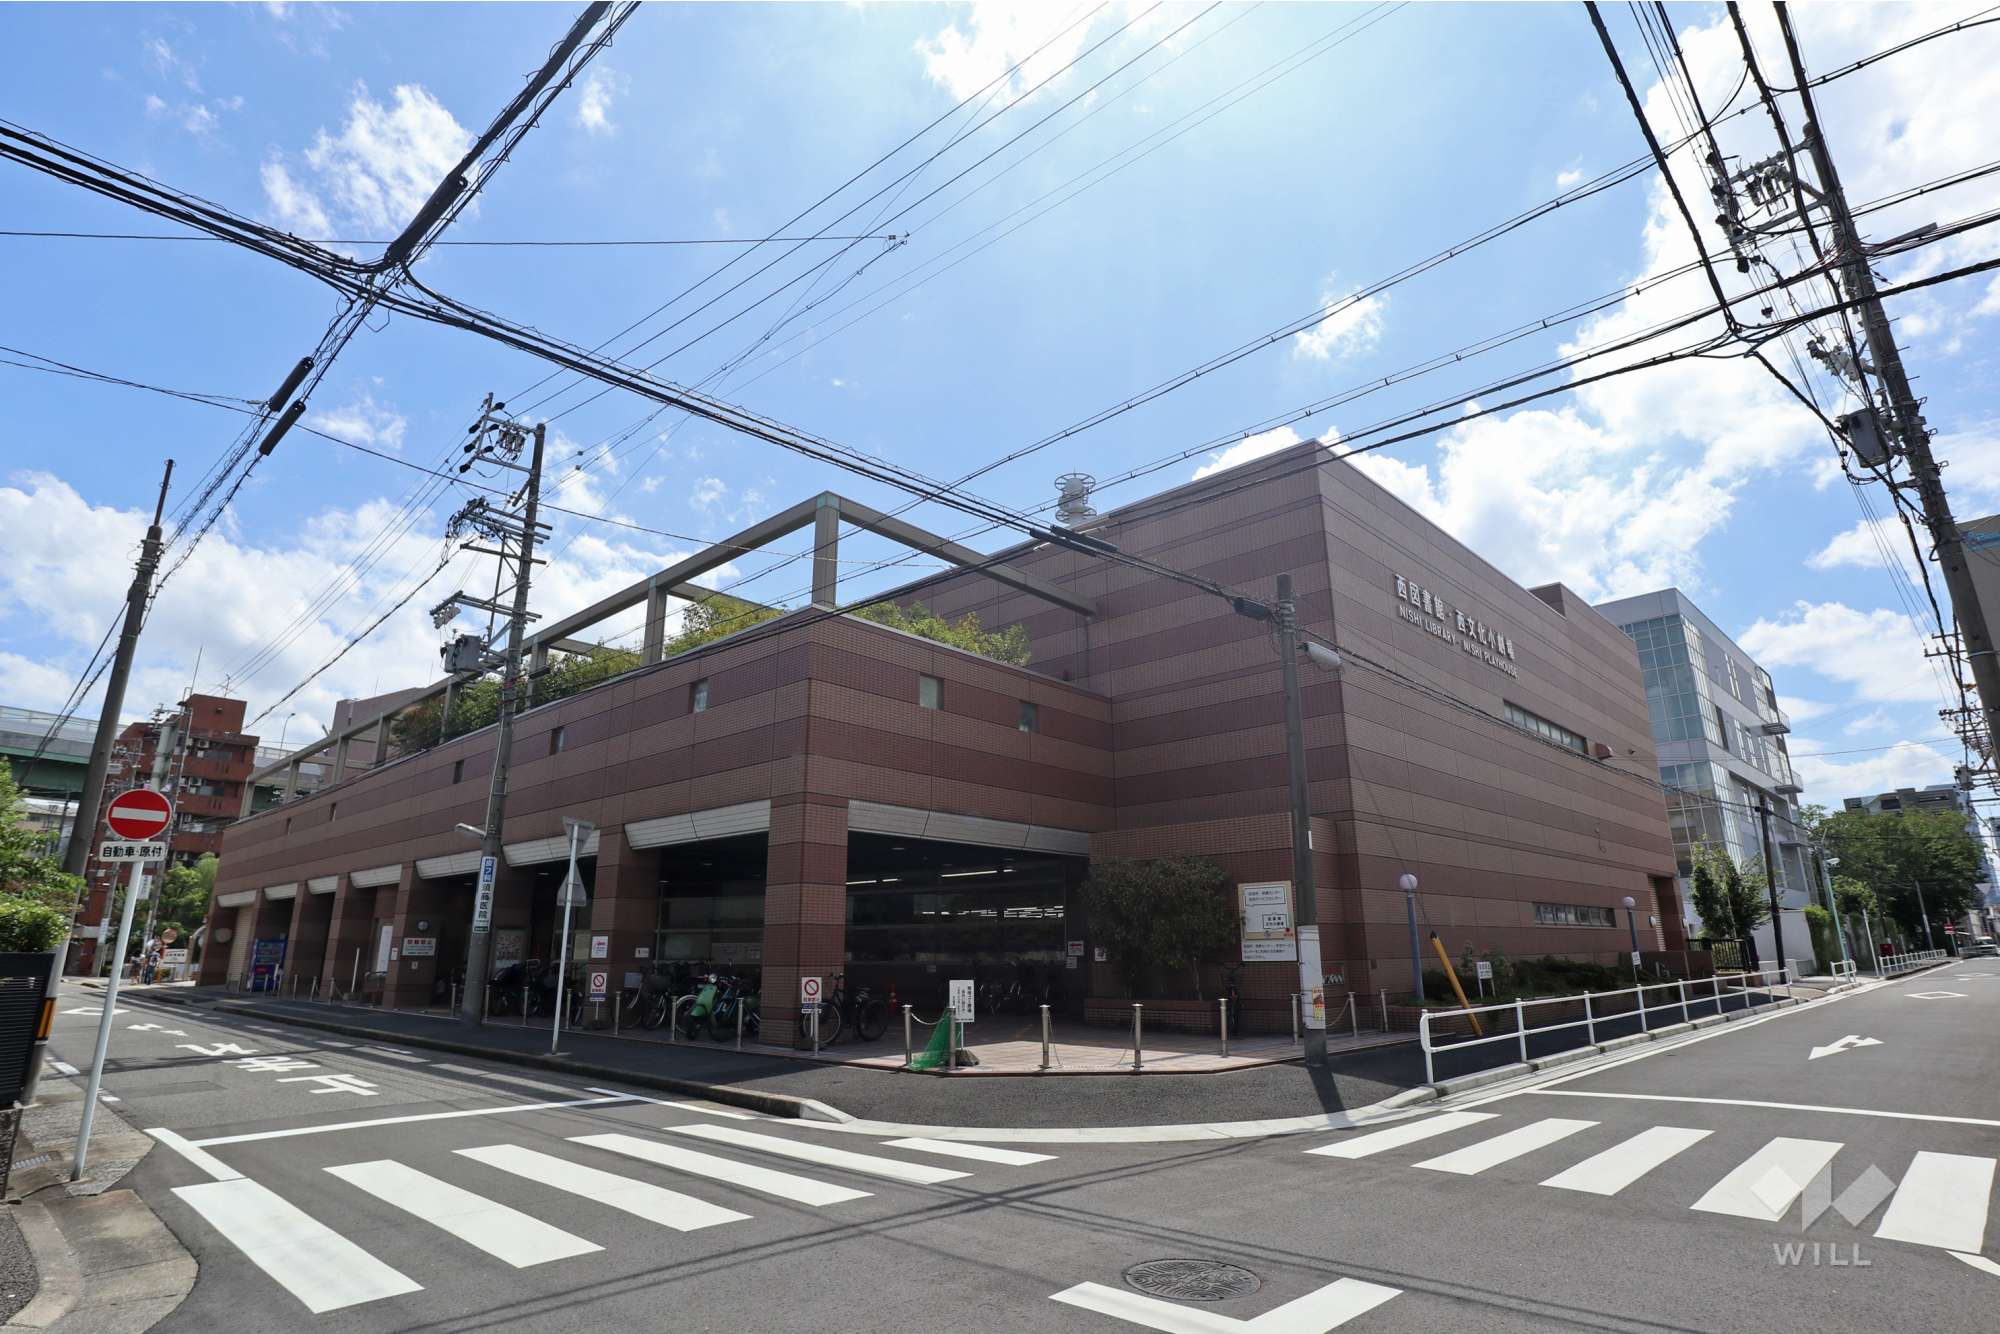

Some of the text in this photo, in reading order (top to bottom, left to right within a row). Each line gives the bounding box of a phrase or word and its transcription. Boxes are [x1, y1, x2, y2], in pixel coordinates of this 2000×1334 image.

[1399, 604, 1423, 629] NISHI
[1463, 639, 1484, 661] NISHI
[1484, 651, 1518, 679] PLAYHOUSE
